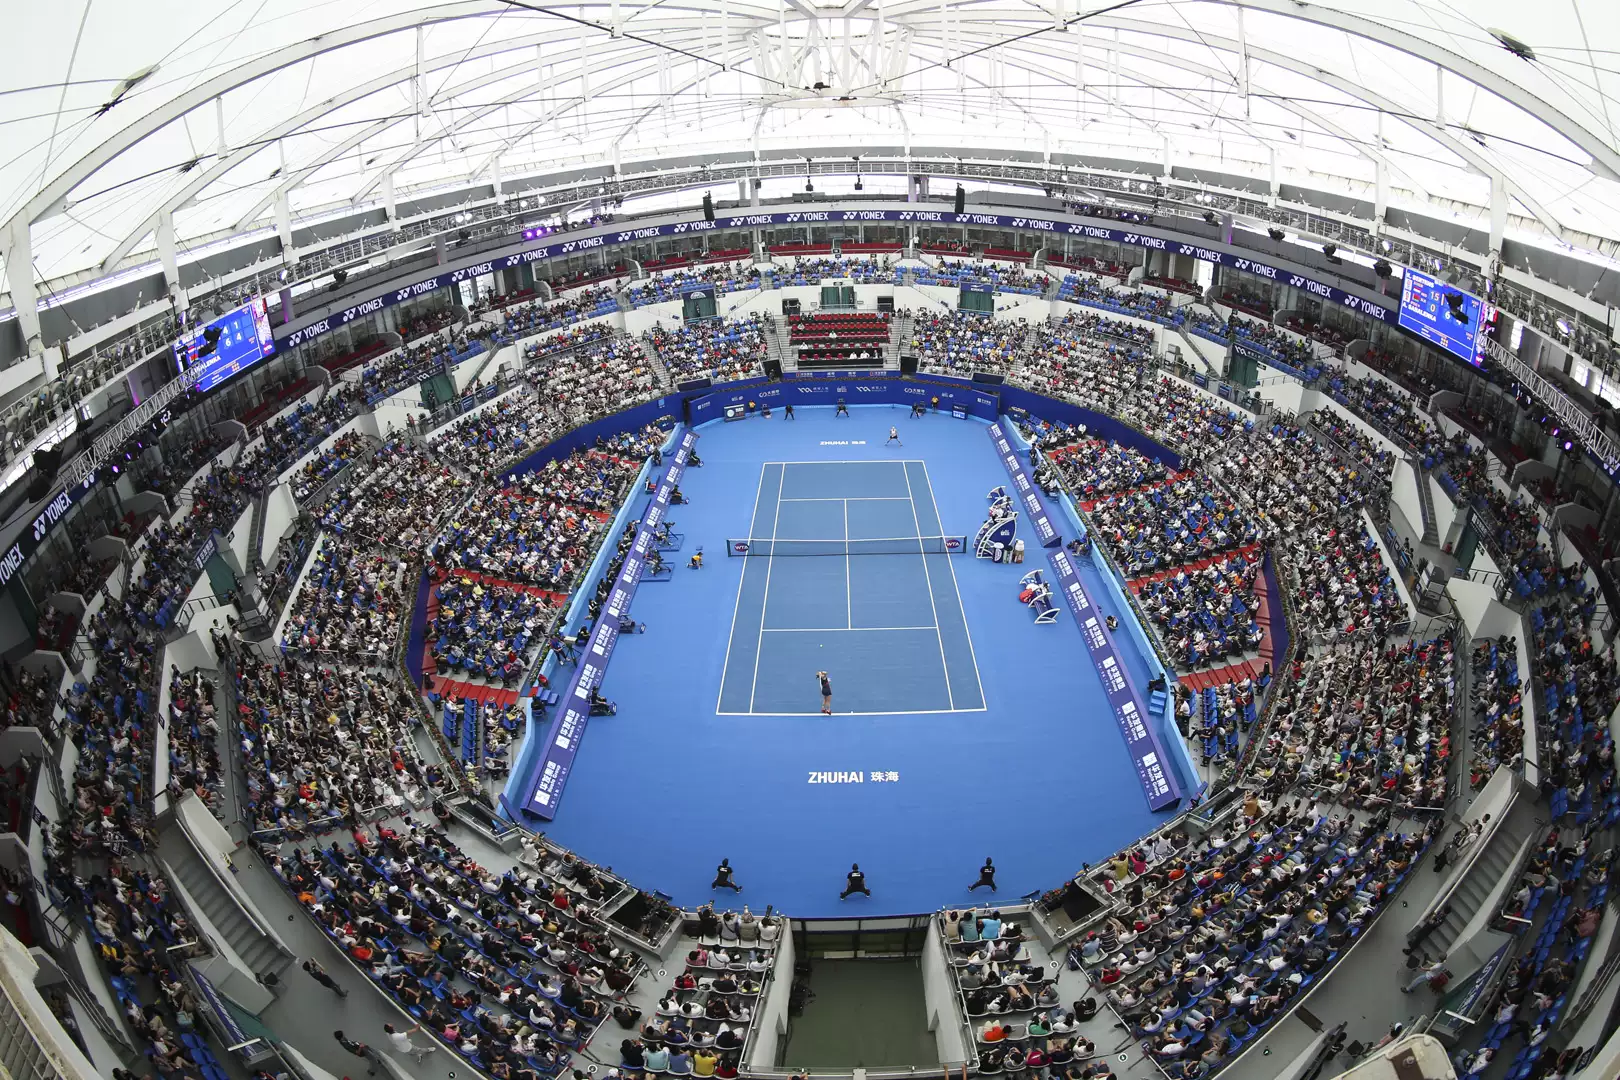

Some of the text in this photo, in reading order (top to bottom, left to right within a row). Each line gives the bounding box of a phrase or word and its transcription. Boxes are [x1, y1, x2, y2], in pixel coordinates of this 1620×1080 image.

[746, 215, 772, 224] YONEX
[803, 212, 828, 221] YONEX
[859, 212, 885, 220] YONEX
[916, 212, 941, 221] YONEX
[972, 215, 998, 225] YONEX
[690, 220, 716, 230] YONEX
[1028, 220, 1054, 230] YONEX
[634, 227, 660, 239] YONEX
[1085, 227, 1110, 239] YONEX
[577, 237, 604, 249] YONEX
[1140, 236, 1166, 249] YONEX
[522, 248, 548, 262] YONEX
[1196, 248, 1221, 262] YONEX
[466, 262, 493, 277] YONEX
[1251, 263, 1276, 279] YONEX
[412, 278, 438, 295] YONEX
[1306, 280, 1332, 298] YONEX
[1430, 291, 1440, 301] 15
[358, 297, 384, 316] YONEX
[1361, 300, 1387, 320] YONEX
[1430, 304, 1450, 319] 0 6
[223, 321, 238, 334] 4 1
[303, 320, 330, 339] YONEX
[225, 332, 242, 346] 6 4
[45, 490, 72, 524] YONEX
[808, 771, 899, 783] ZHUHAI 珠海
